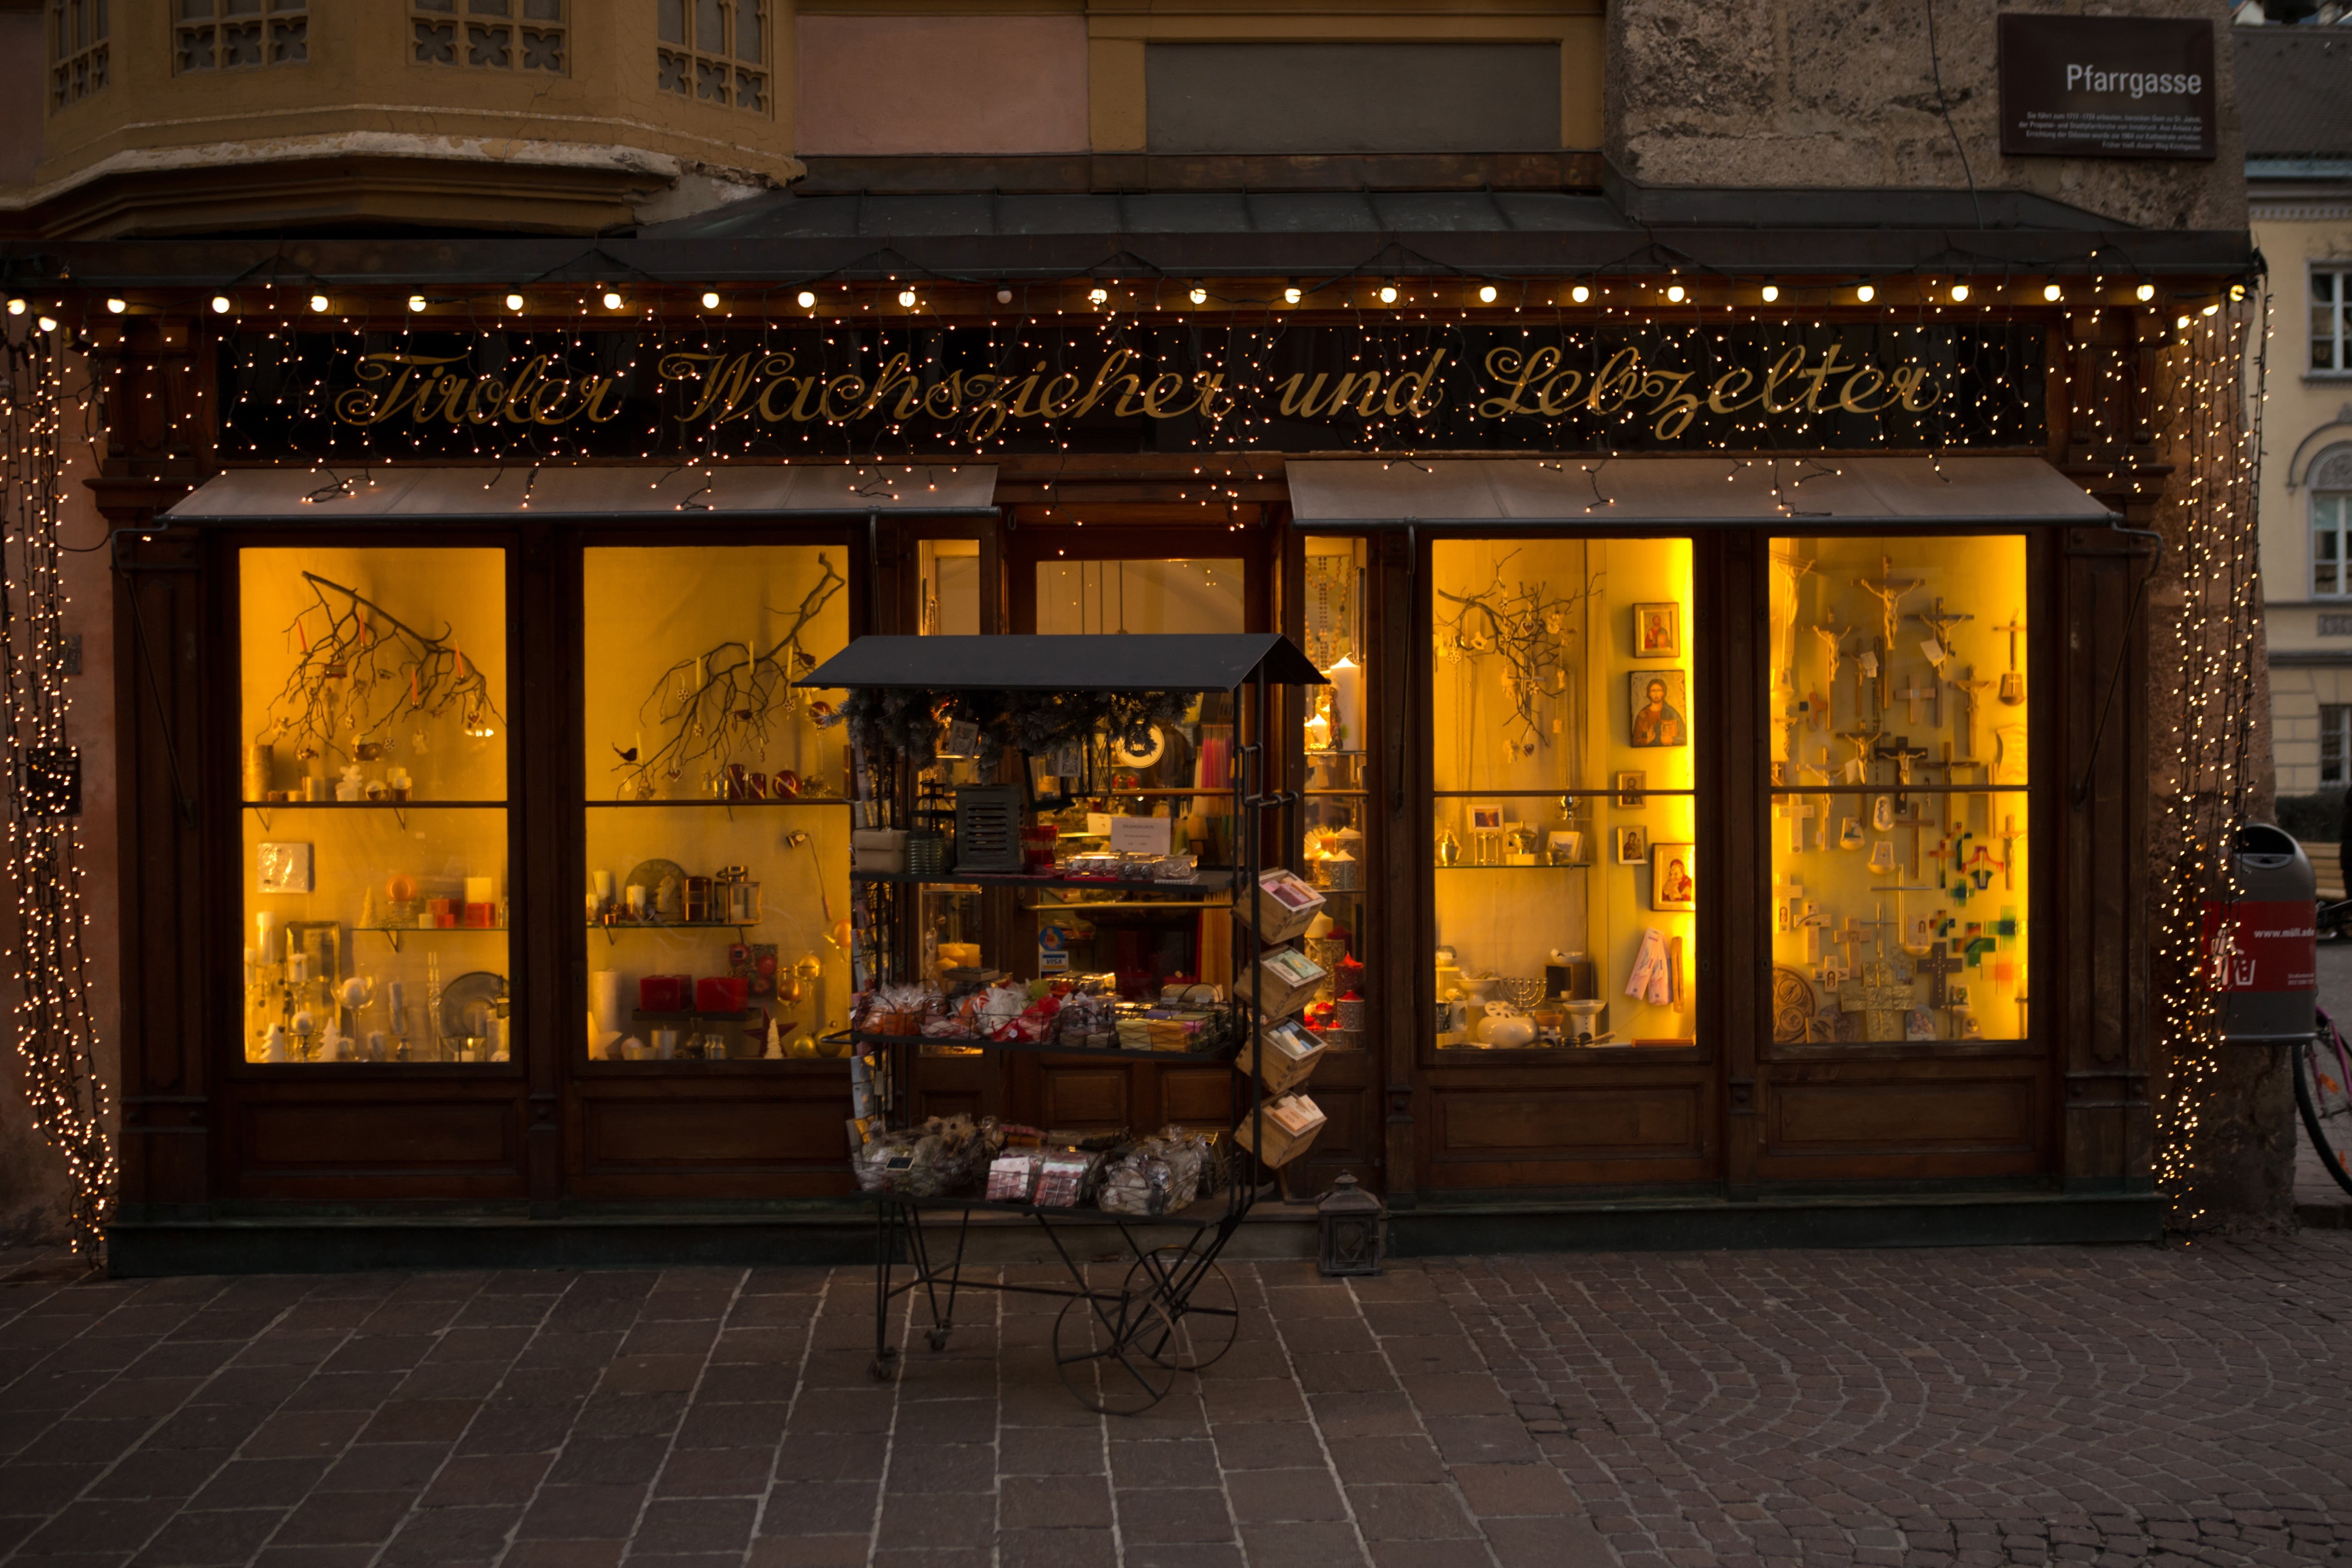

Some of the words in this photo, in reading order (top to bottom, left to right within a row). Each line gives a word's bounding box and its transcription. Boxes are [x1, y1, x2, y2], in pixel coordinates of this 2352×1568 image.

[2067, 64, 2202, 99] Pfarrgasse
[335, 353, 622, 426] Tiroler
[658, 349, 1235, 443] Wachszieher
[1275, 348, 1446, 416] und
[1478, 344, 1941, 441] Lebzelter
